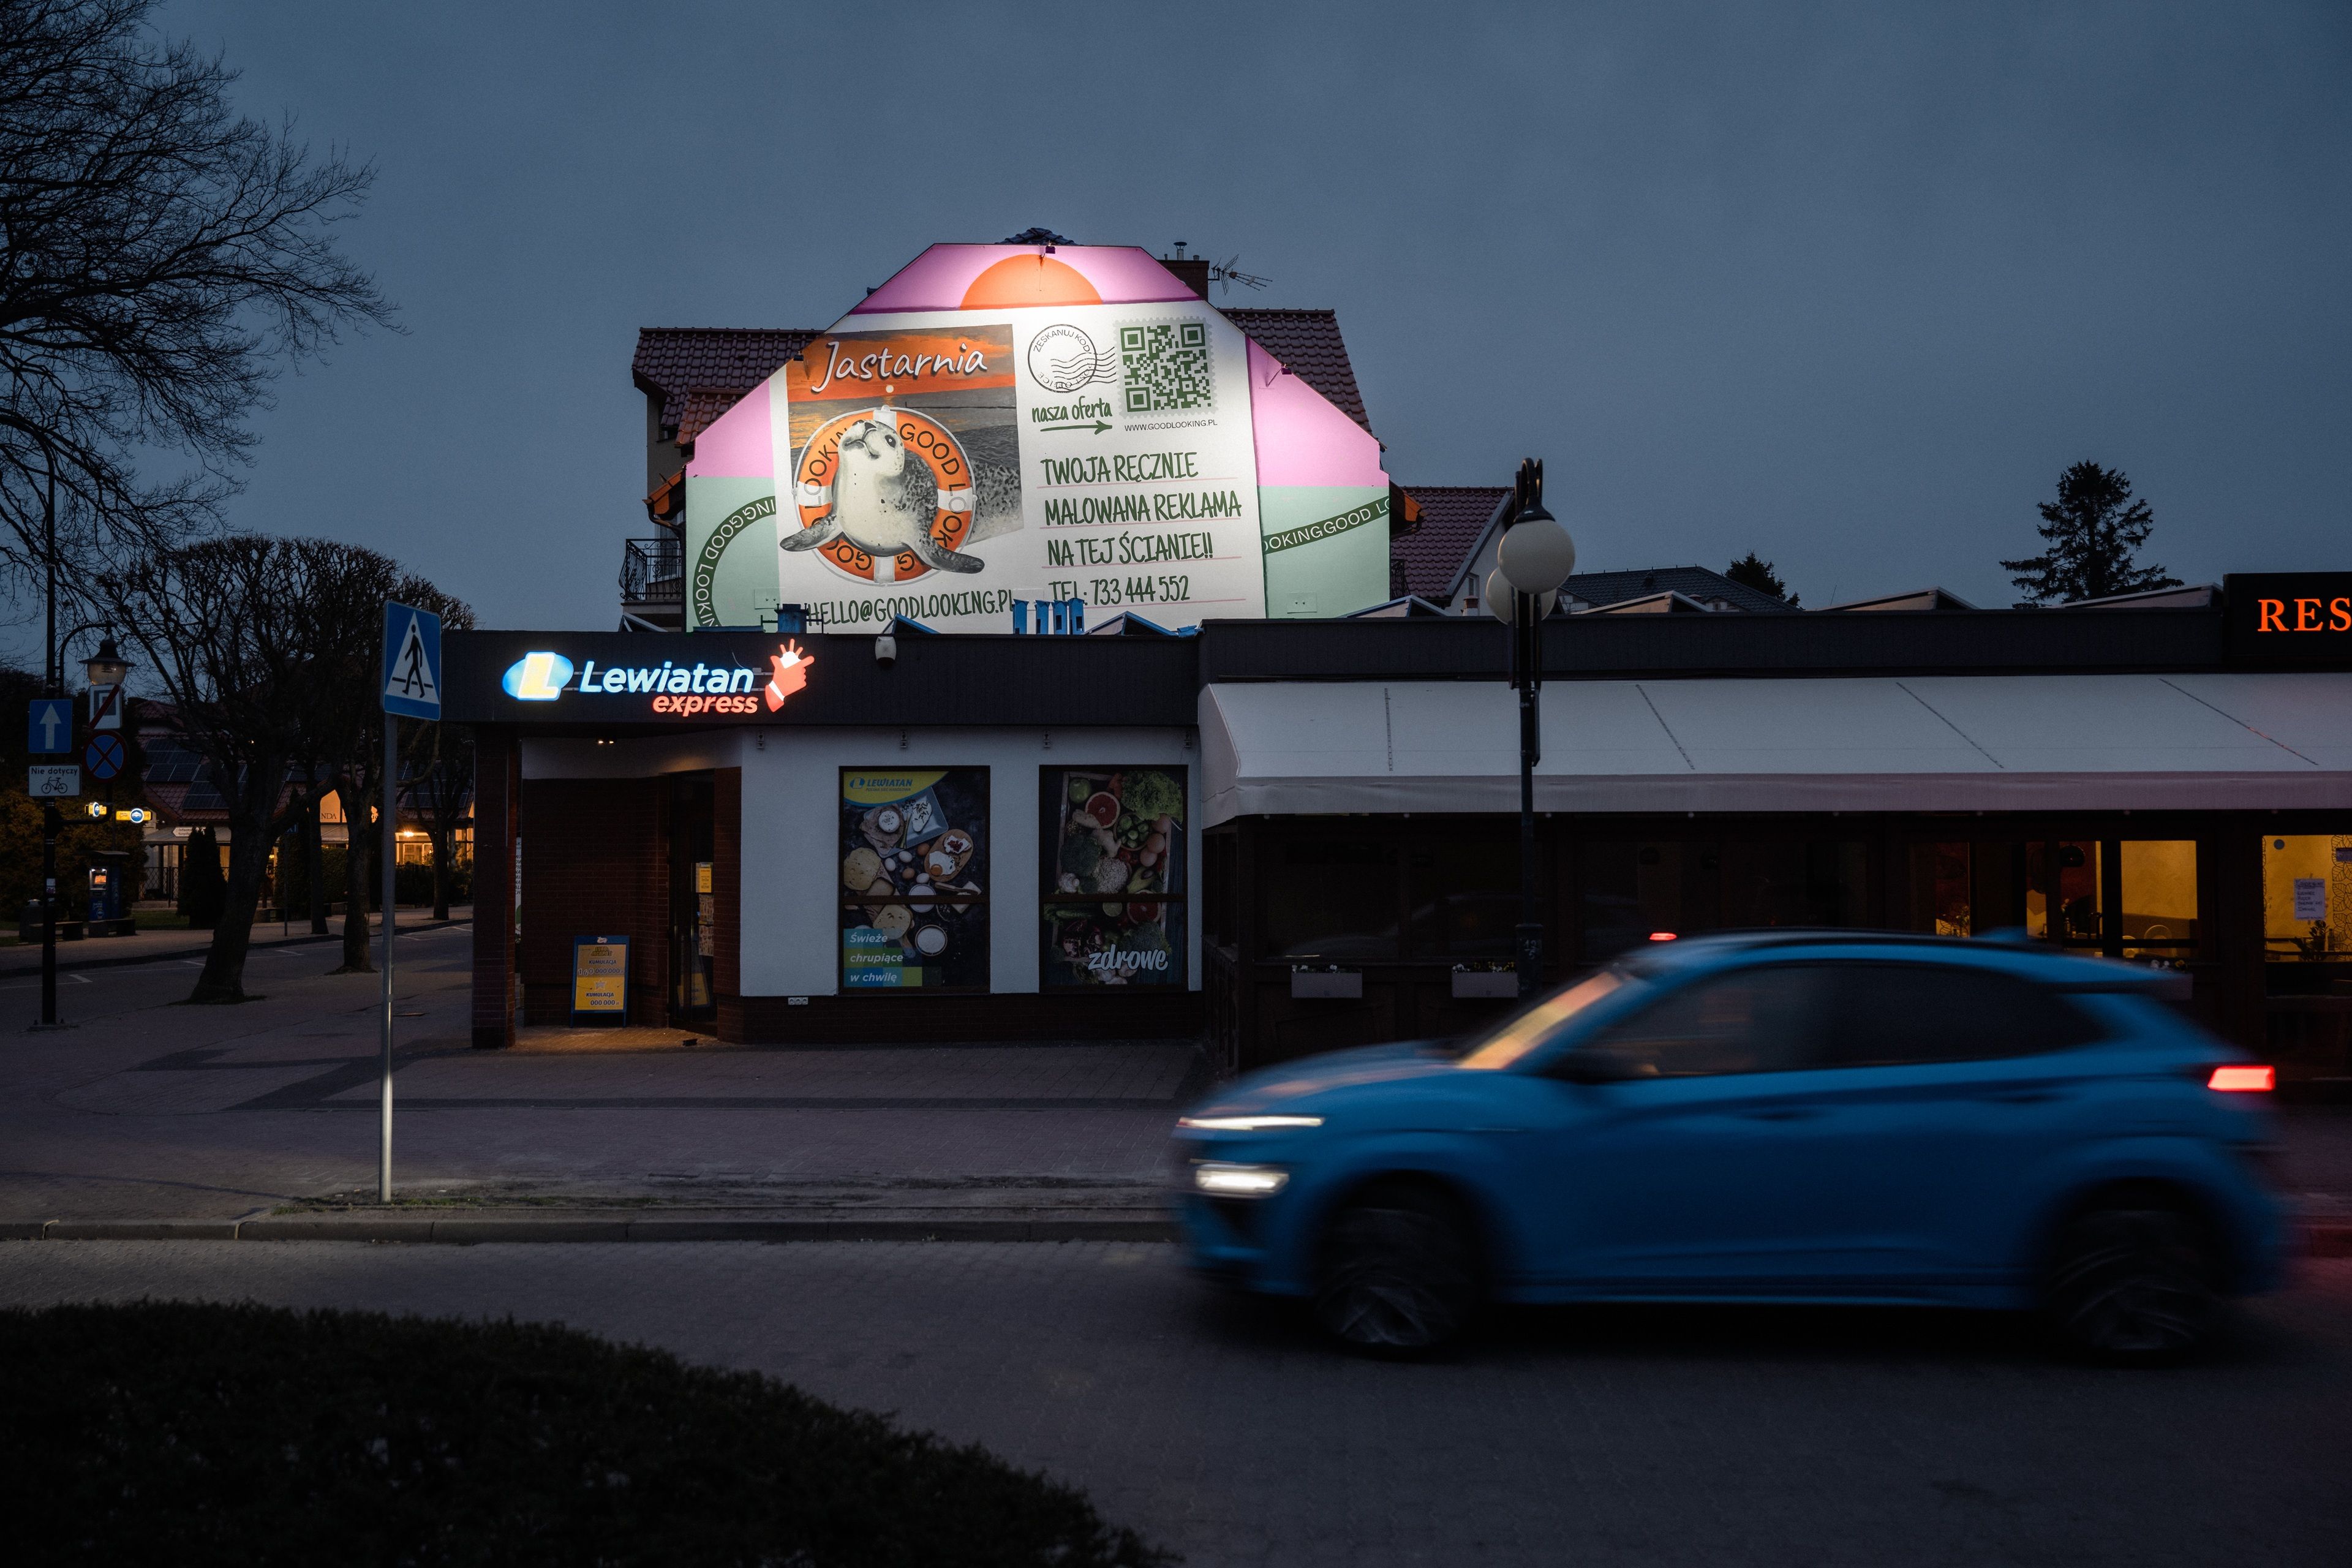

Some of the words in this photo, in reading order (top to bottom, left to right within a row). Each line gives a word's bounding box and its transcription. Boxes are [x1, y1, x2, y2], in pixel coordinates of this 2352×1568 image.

[1033, 330, 1074, 352] ZESKANUJ
[1074, 334, 1090, 352] KOD
[812, 341, 988, 392] Jastarnia
[1032, 405, 1068, 423] nasza
[1072, 396, 1113, 419] oferta
[1125, 419, 1218, 432] WWW.GOODLOOKING.PL
[899, 423, 960, 475] GOOD
[1041, 456, 1111, 485] TWOJA
[1114, 452, 1198, 483] RĘCZNIE
[1045, 494, 1151, 526] MALOWANA
[1153, 491, 1242, 521] REKLAMA
[1323, 508, 1371, 534] GOOD
[705, 515, 744, 560] GOOD
[1047, 540, 1074, 567] NA
[1075, 537, 1115, 565] TEJ
[1119, 530, 1213, 564] ŚCIANIE!!
[1090, 579, 1121, 606] 733
[1125, 576, 1156, 603] 444
[1159, 575, 1190, 602] 552
[2258, 598, 2352, 631] RES
[579, 660, 755, 694] Lewiatan
[652, 695, 759, 717] express
[867, 778, 913, 787] LEWIATAN
[850, 932, 888, 943] Świeże
[850, 953, 904, 963] chrupiące
[1088, 943, 1169, 971] zdrowe
[862, 973, 897, 983] chwilę
